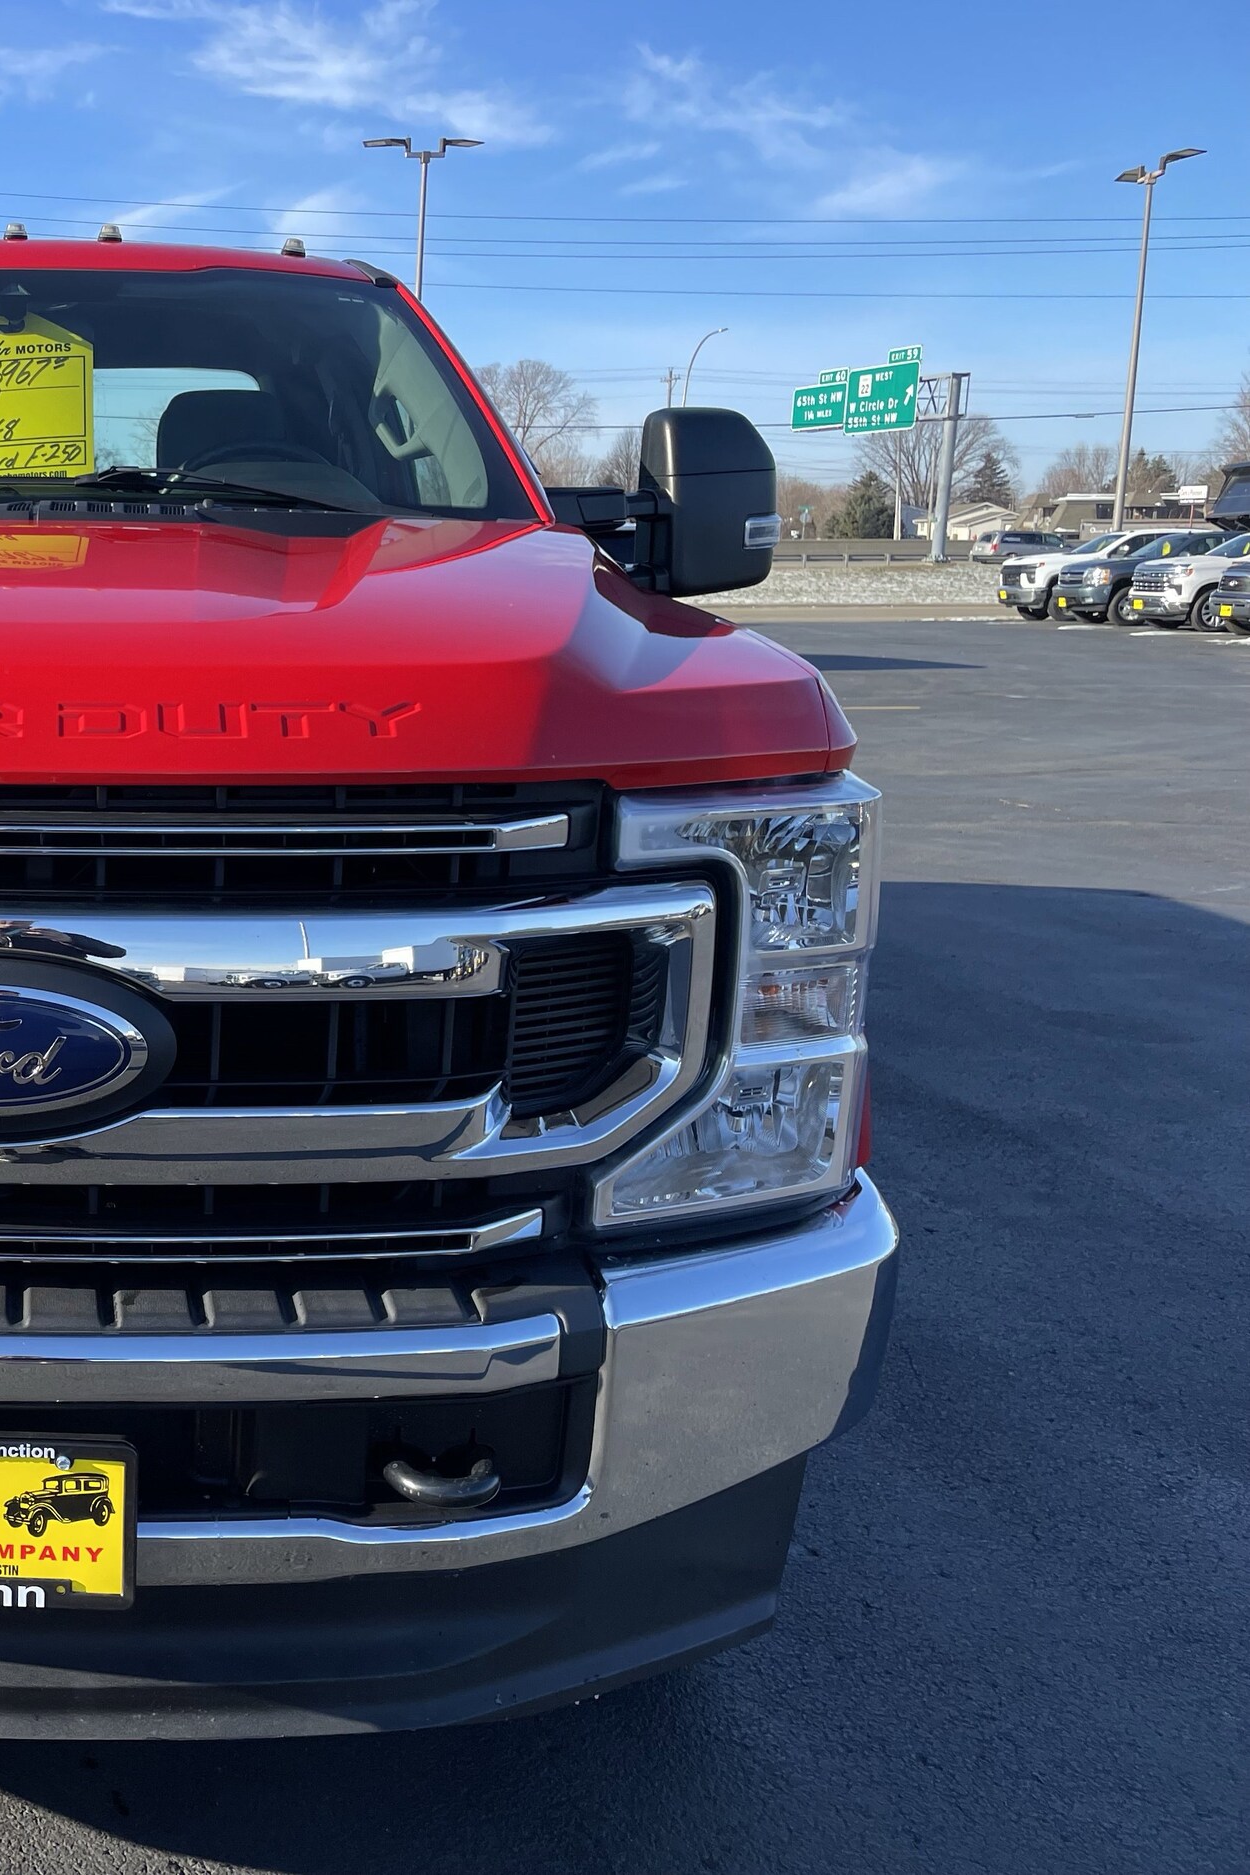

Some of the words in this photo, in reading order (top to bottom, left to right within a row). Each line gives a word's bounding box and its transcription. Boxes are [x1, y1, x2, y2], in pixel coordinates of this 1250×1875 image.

[15, 343, 71, 354] MOTORS
[891, 351, 905, 361] EXIT
[907, 348, 918, 360] 59
[821, 373, 833, 382] EXIT
[836, 370, 846, 382] 60
[860, 384, 870, 394] 22
[875, 371, 893, 382] WEST
[796, 395, 815, 407] 65th
[819, 393, 827, 404] St
[831, 391, 843, 403] NW
[849, 402, 856, 413] W
[860, 400, 885, 413] Circle
[888, 397, 899, 409] Dr
[817, 409, 832, 418] MILES
[847, 416, 867, 428] 55th
[871, 415, 881, 426] St
[884, 412, 898, 425] NW
[24, 443, 82, 468] F-250
[58, 702, 423, 739] DUTY
